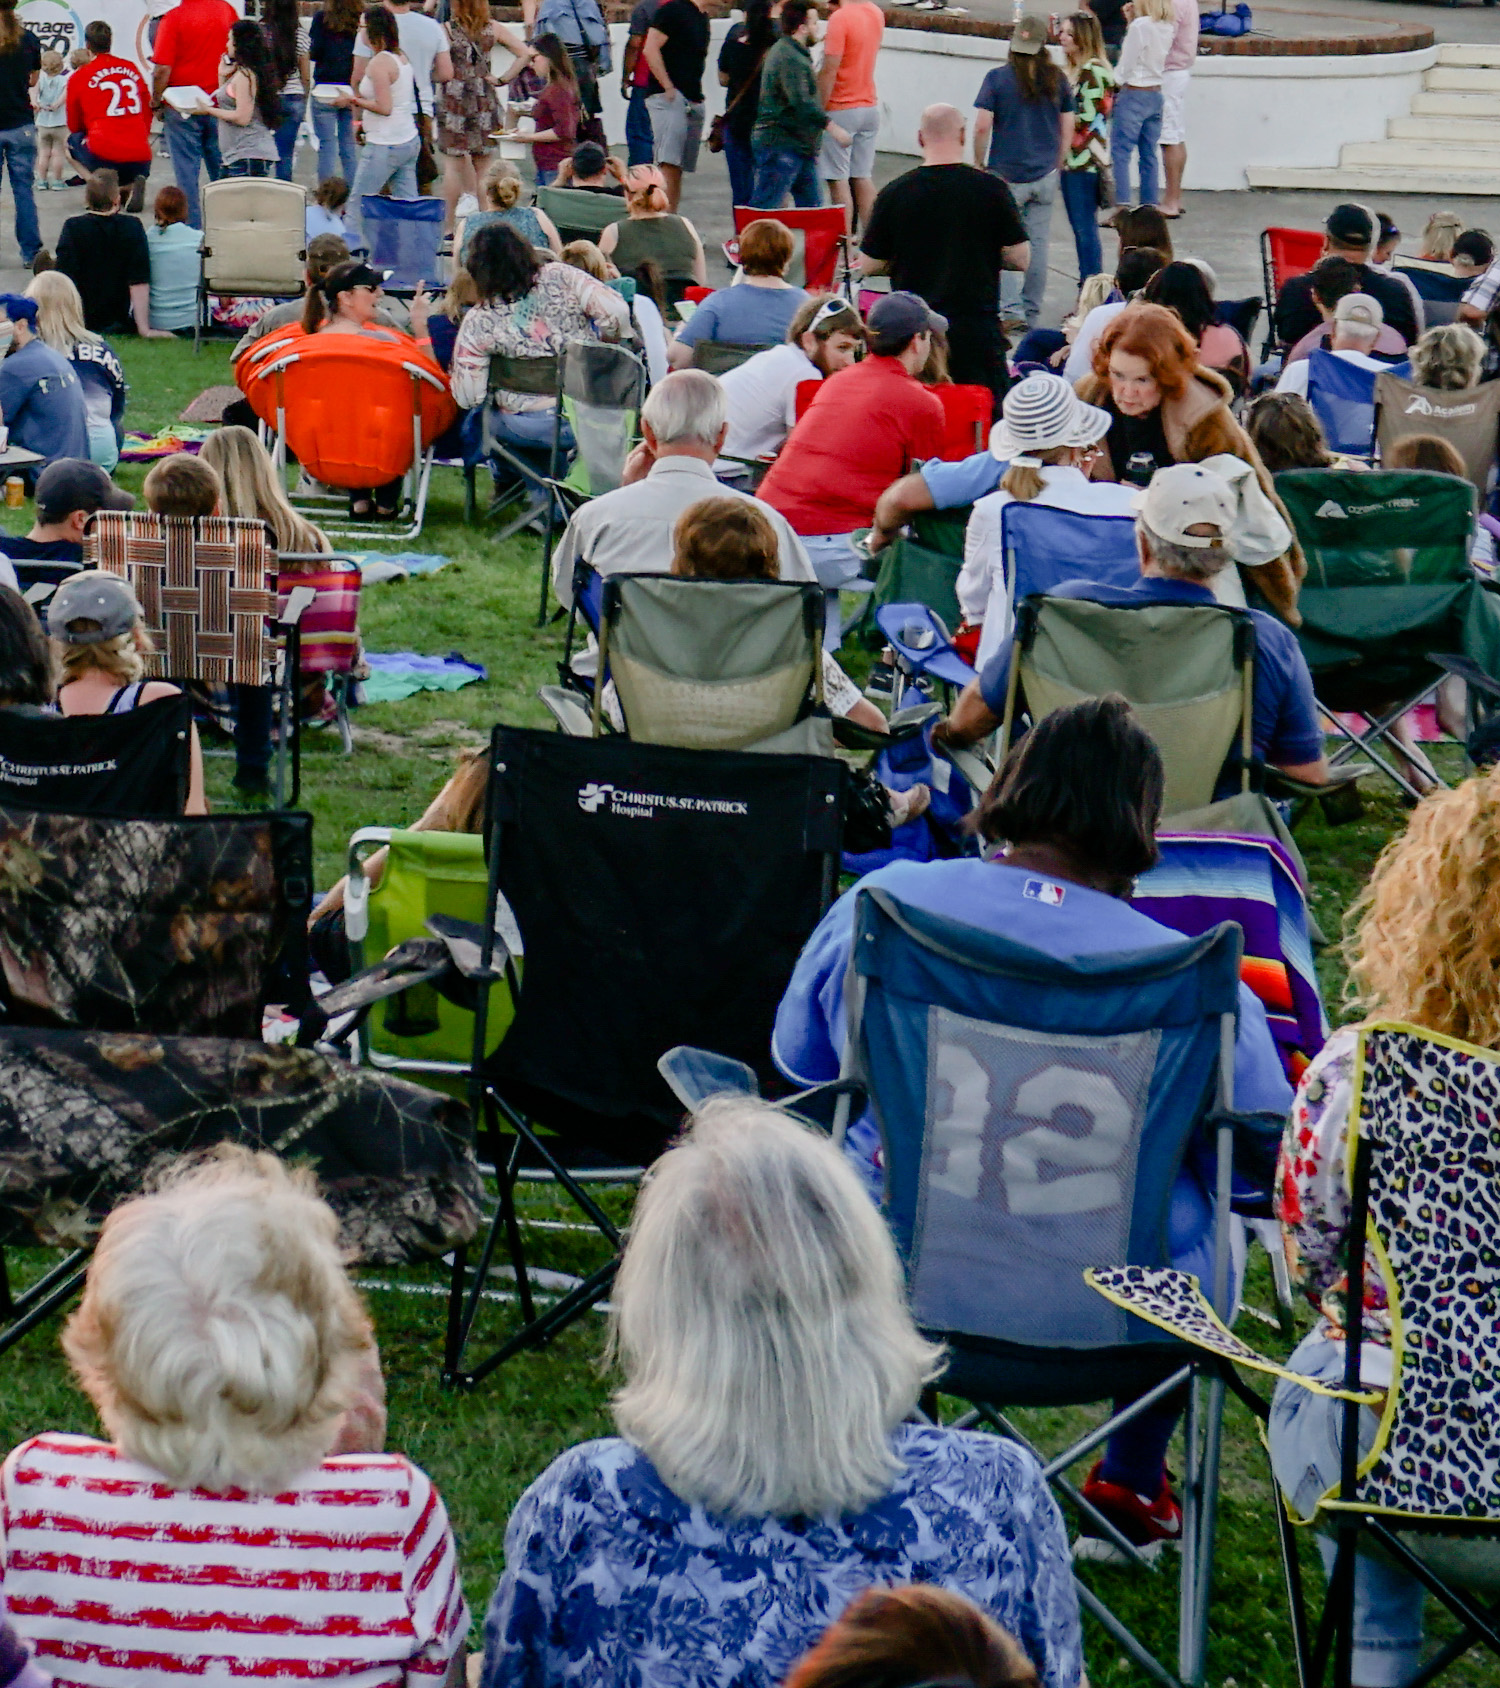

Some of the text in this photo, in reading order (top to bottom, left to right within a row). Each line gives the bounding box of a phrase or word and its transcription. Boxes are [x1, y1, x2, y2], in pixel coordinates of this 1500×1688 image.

[24, 21, 75, 35] mage
[99, 78, 141, 117] 23
[611, 803, 654, 819] Hospital
[696, 799, 748, 815] PATRICK
